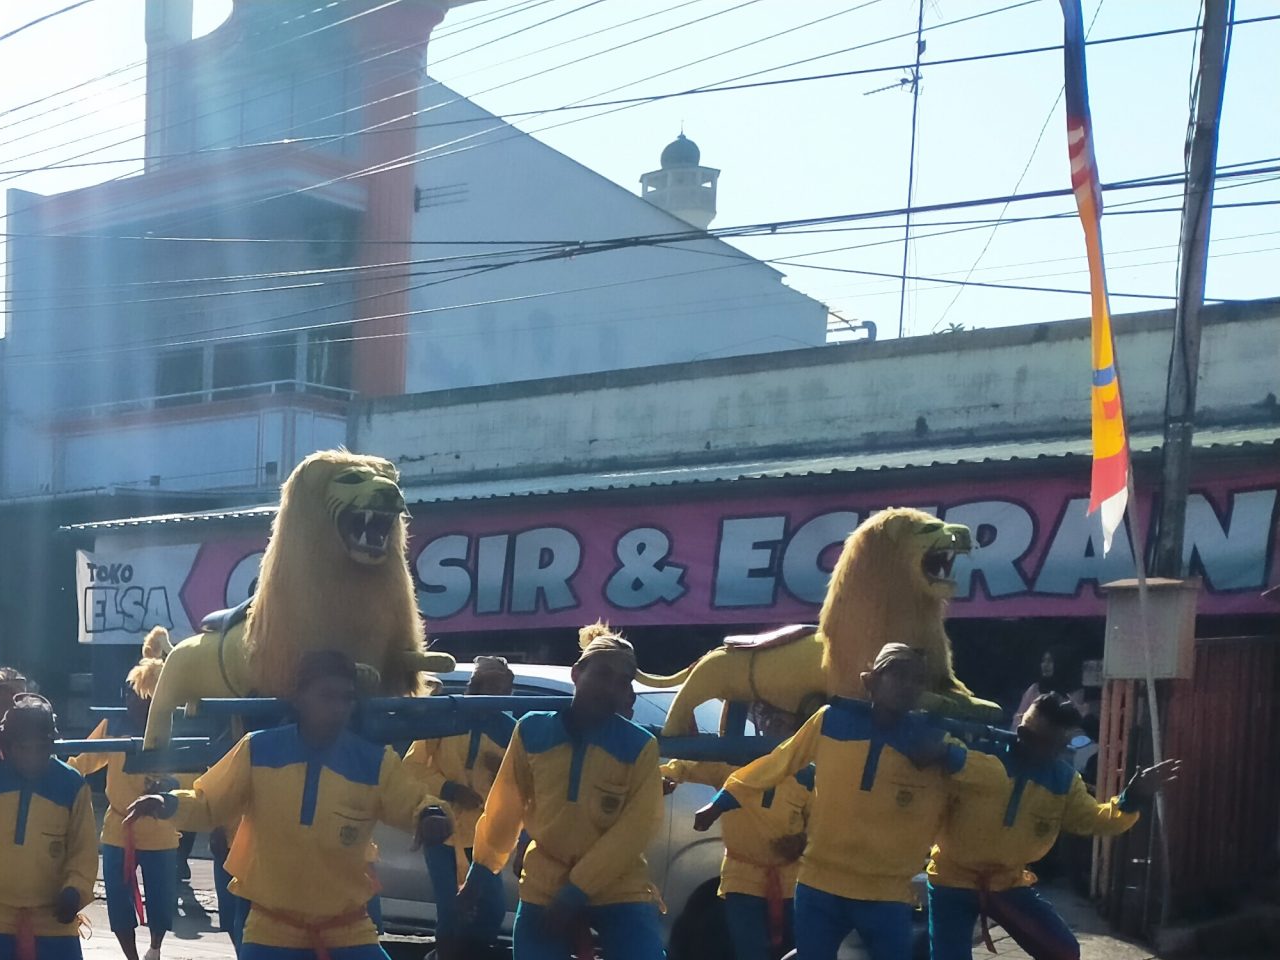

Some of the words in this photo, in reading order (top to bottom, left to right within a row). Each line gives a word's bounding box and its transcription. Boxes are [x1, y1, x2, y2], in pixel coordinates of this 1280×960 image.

[87, 562, 133, 585] TOKO
[606, 523, 691, 610] &
[84, 586, 174, 633] ELSA
